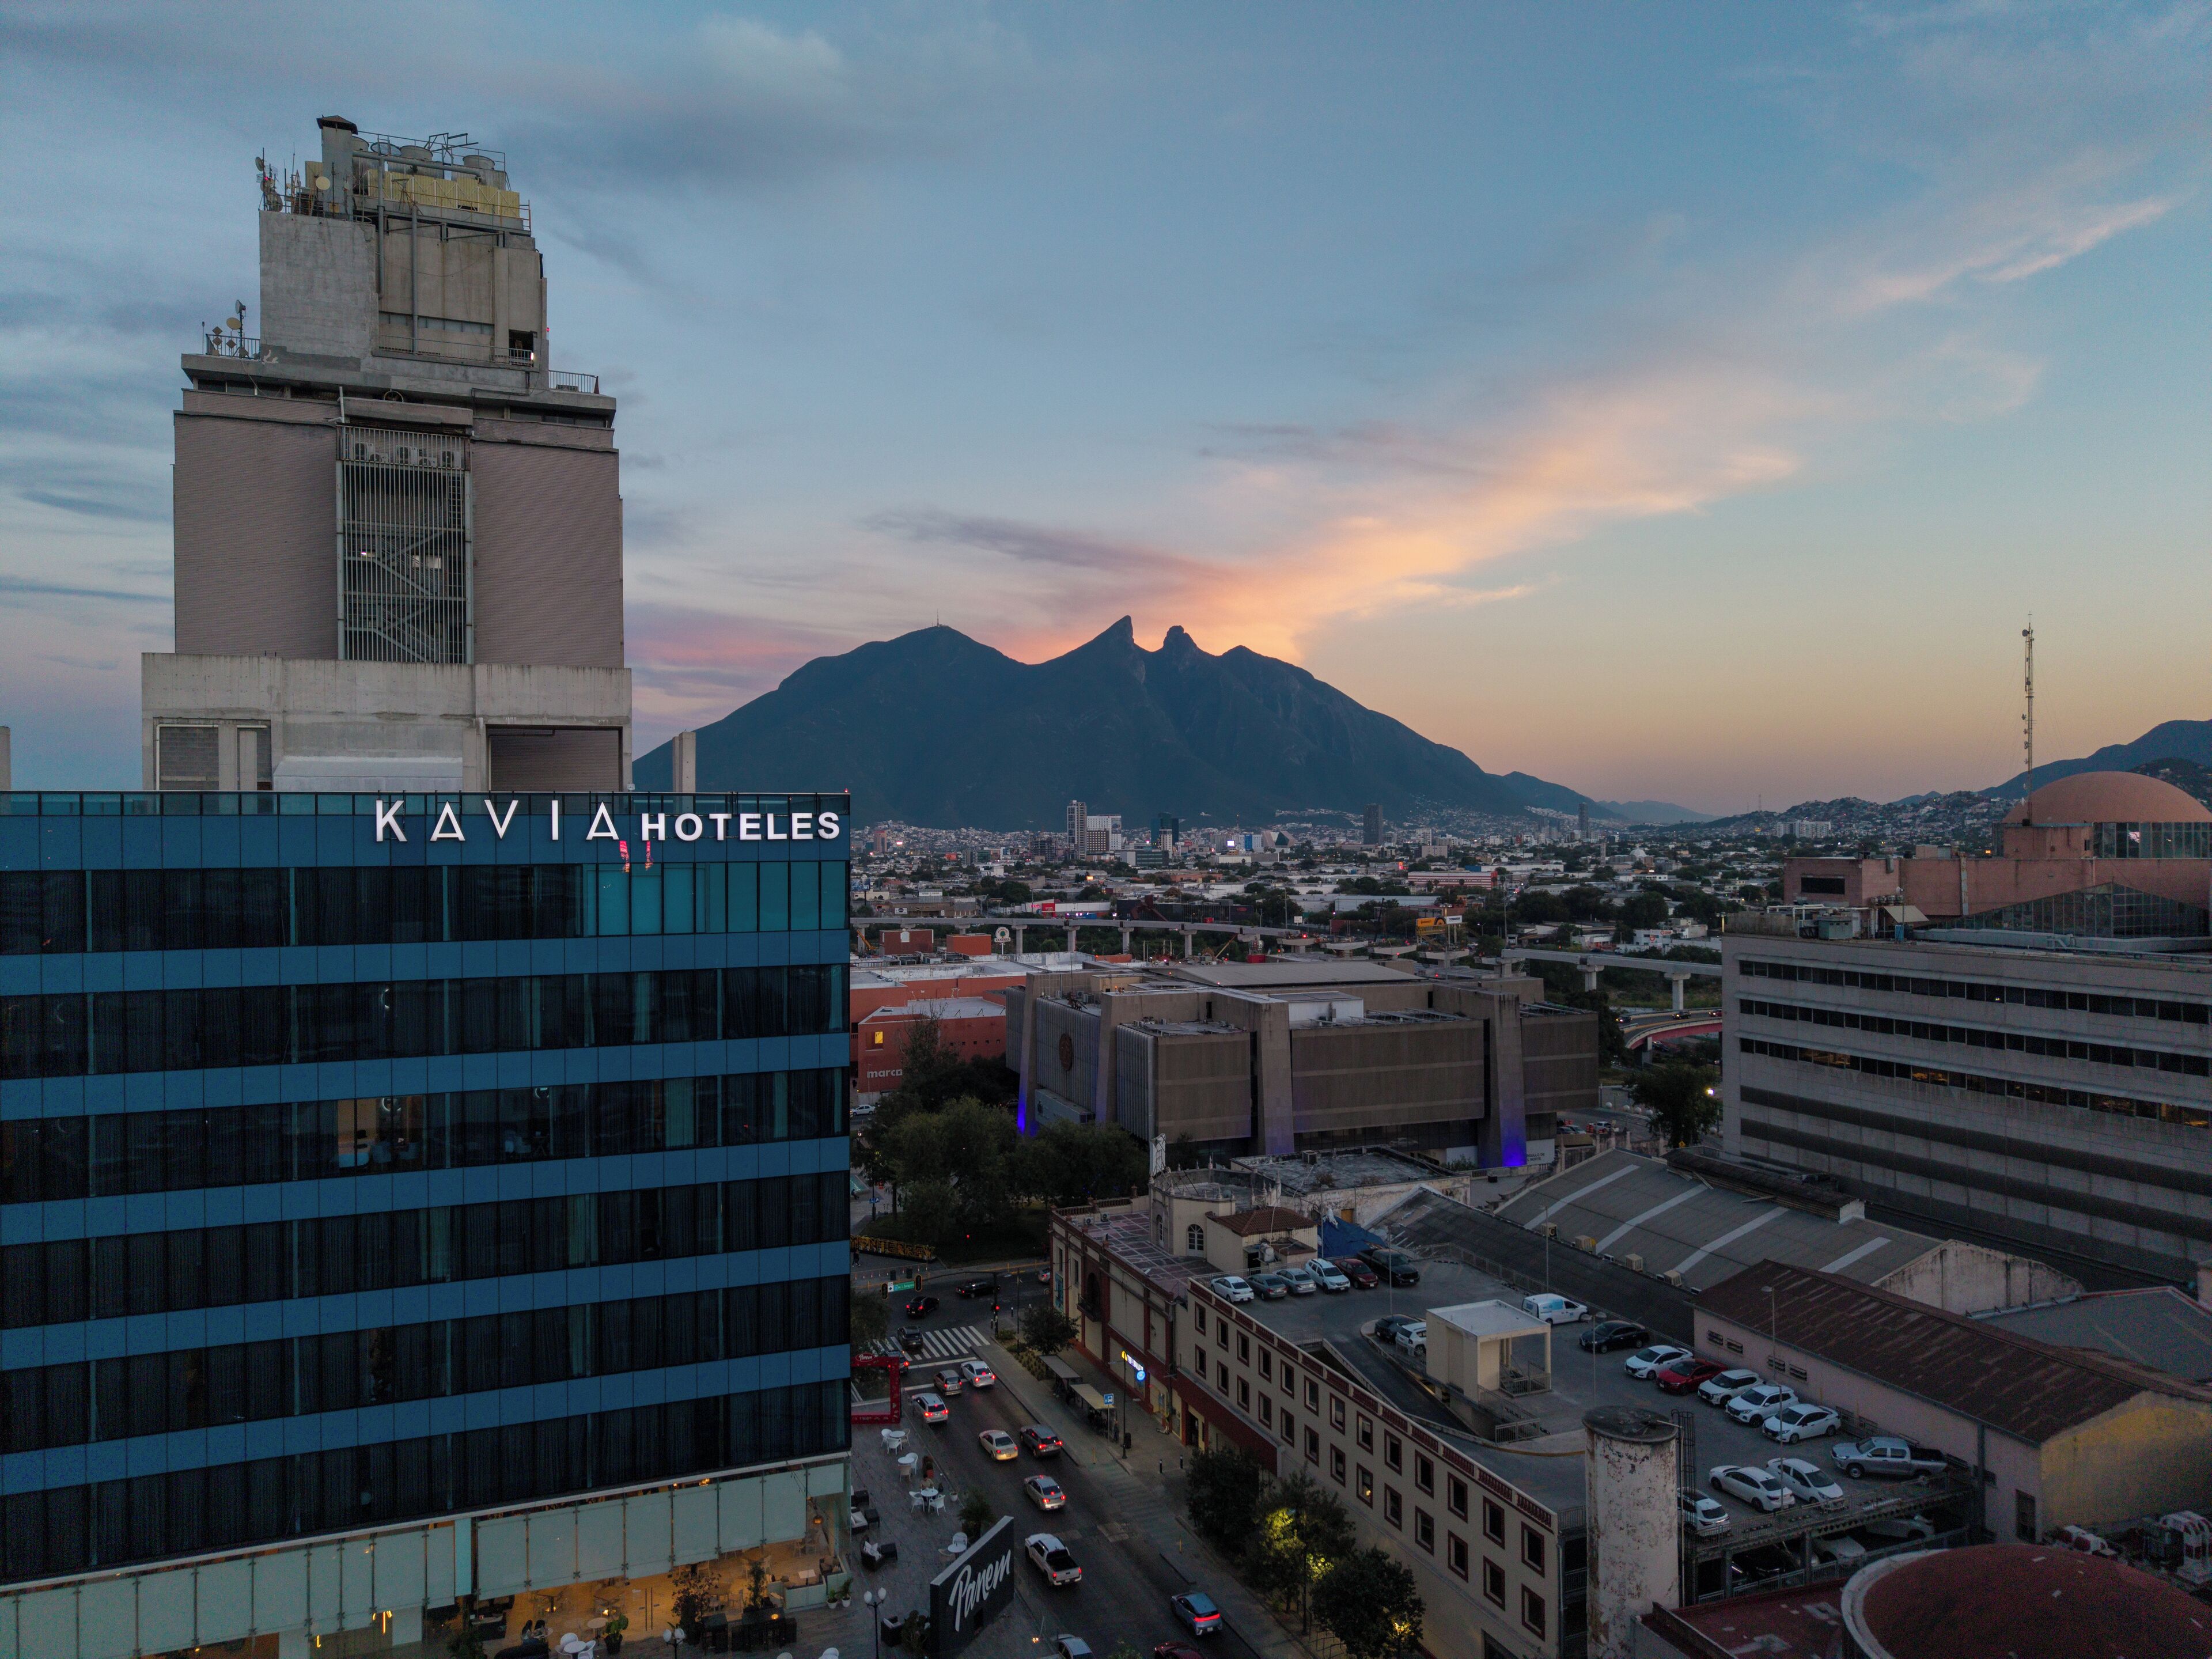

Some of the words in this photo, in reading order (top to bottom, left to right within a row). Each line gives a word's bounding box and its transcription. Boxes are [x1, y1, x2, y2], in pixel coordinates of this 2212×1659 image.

[376, 800, 620, 842] KAVIA
[641, 812, 840, 842] HOTELES
[867, 1069, 903, 1078] marco
[948, 1549, 1012, 1632] Panem
